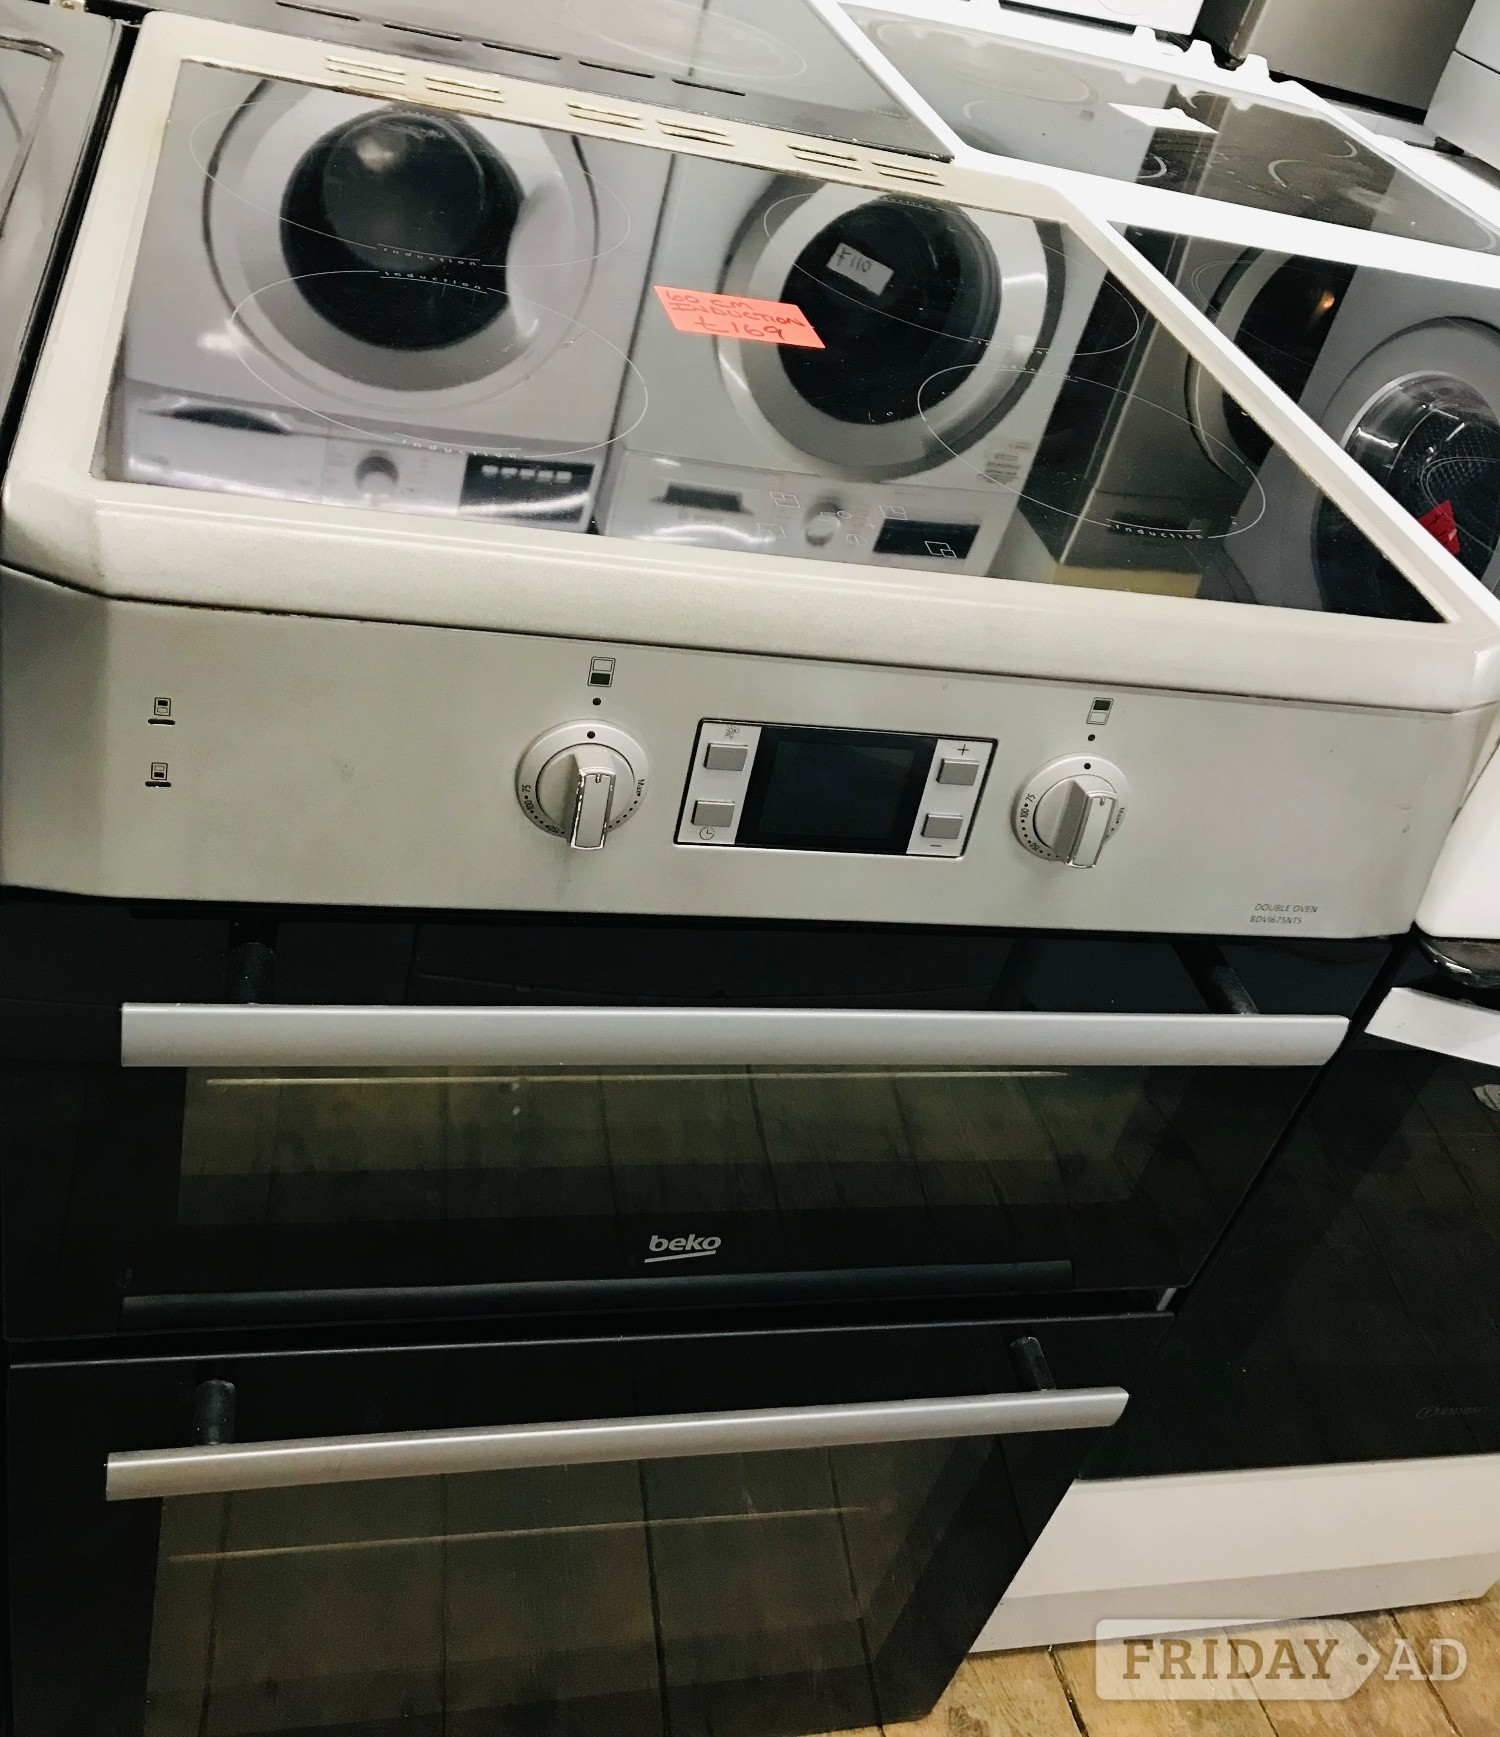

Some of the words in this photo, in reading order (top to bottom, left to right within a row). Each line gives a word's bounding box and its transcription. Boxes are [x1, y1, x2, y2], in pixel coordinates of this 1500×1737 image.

[668, 302, 806, 327] INDUCTION
[521, 784, 531, 793] 75
[1025, 793, 1035, 803] 75
[1020, 808, 1029, 818] 100
[1254, 903, 1291, 912] DOUBLE
[1293, 905, 1319, 913] OVEN
[648, 1234, 721, 1252] beko
